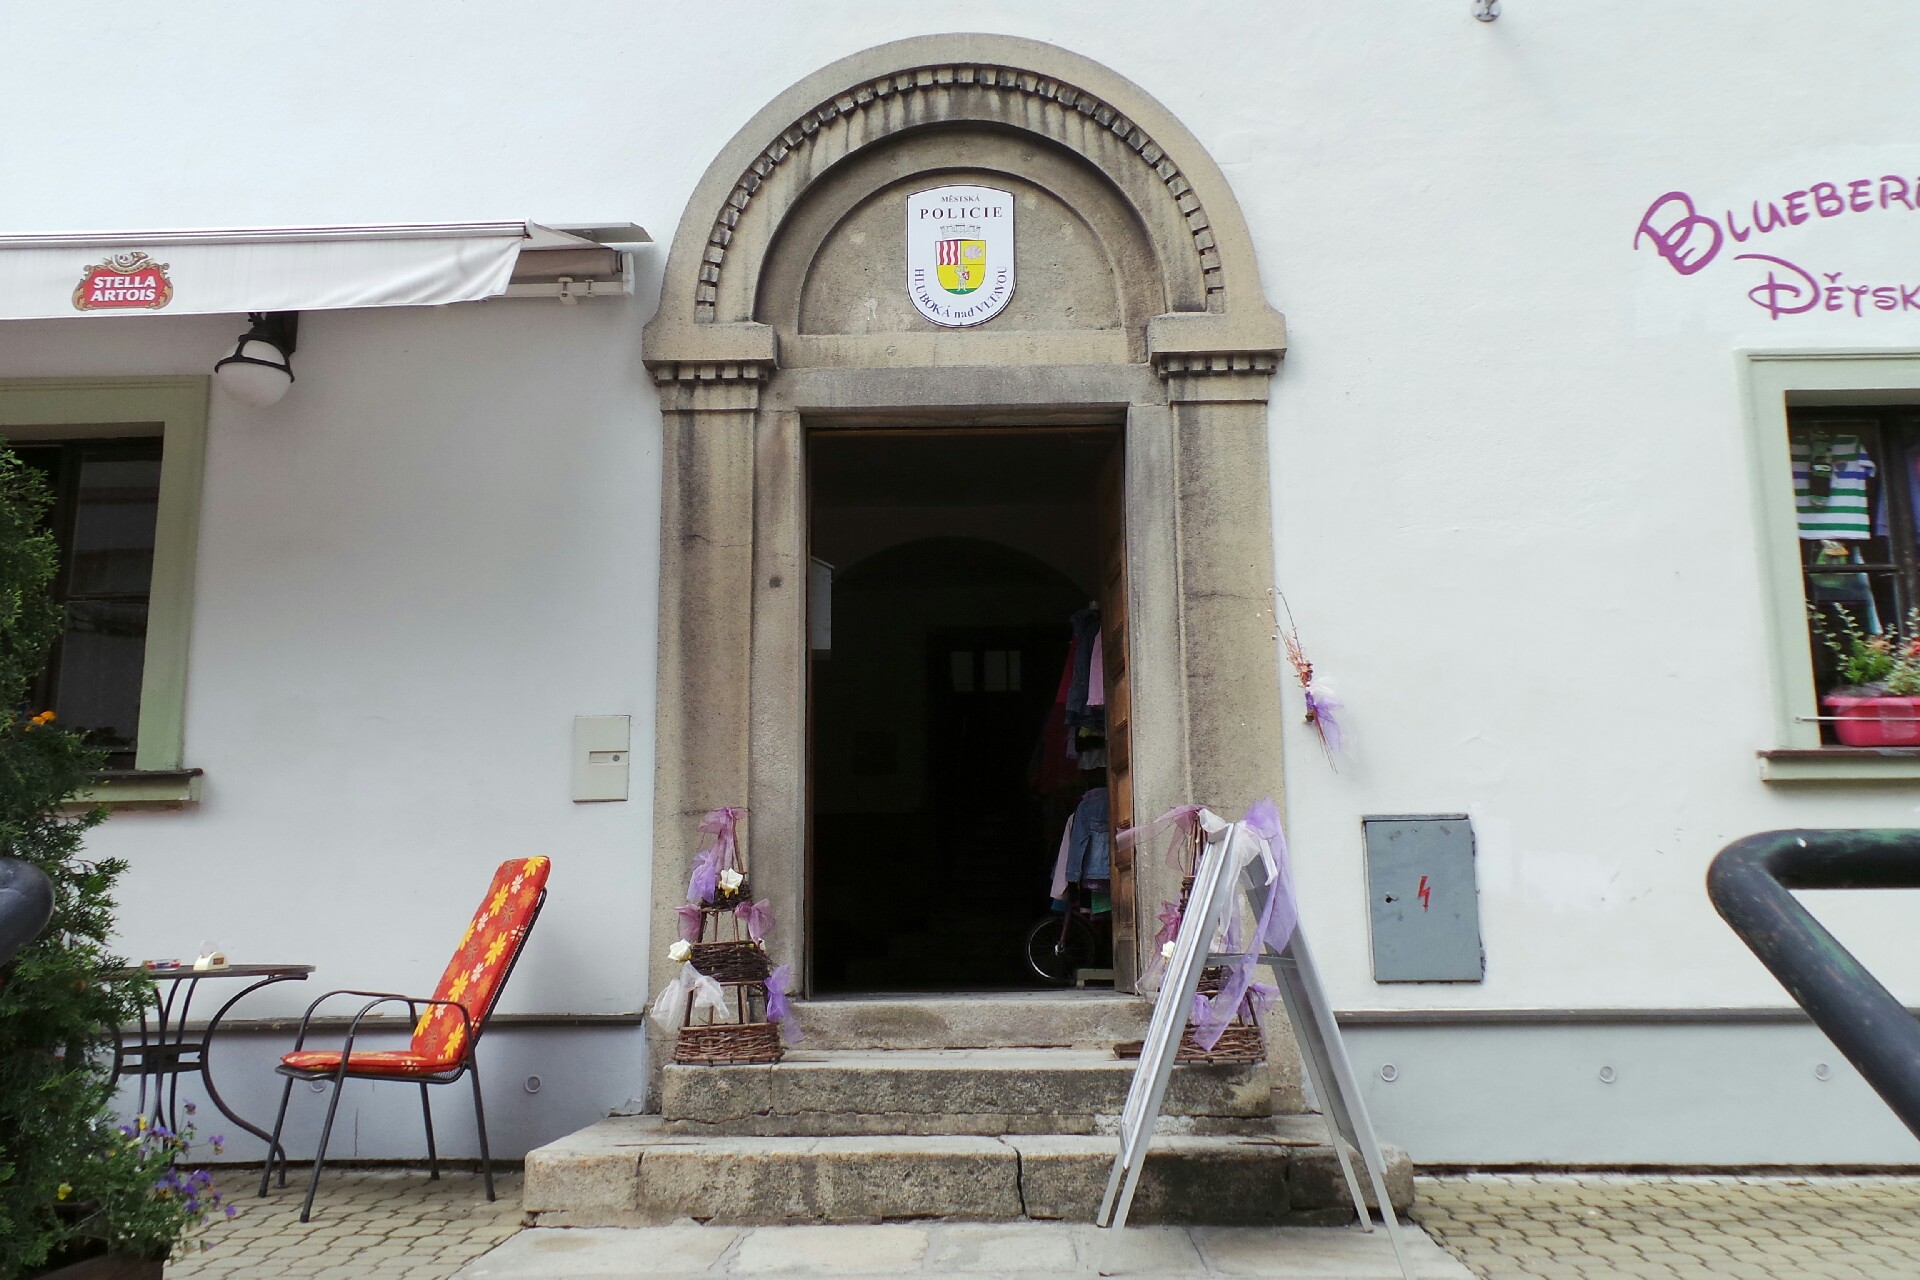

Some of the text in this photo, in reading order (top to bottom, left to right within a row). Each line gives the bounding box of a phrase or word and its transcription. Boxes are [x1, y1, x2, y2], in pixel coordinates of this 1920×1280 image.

[941, 194, 980, 203] MĚSTSKÁ
[920, 207, 1002, 219] POLICIE
[1634, 175, 1920, 275] BLUEBER
[93, 276, 156, 288] STELLA
[90, 289, 155, 301] ARTOIS
[914, 266, 1008, 319] HLUBOKÁ nad VLTAVOU
